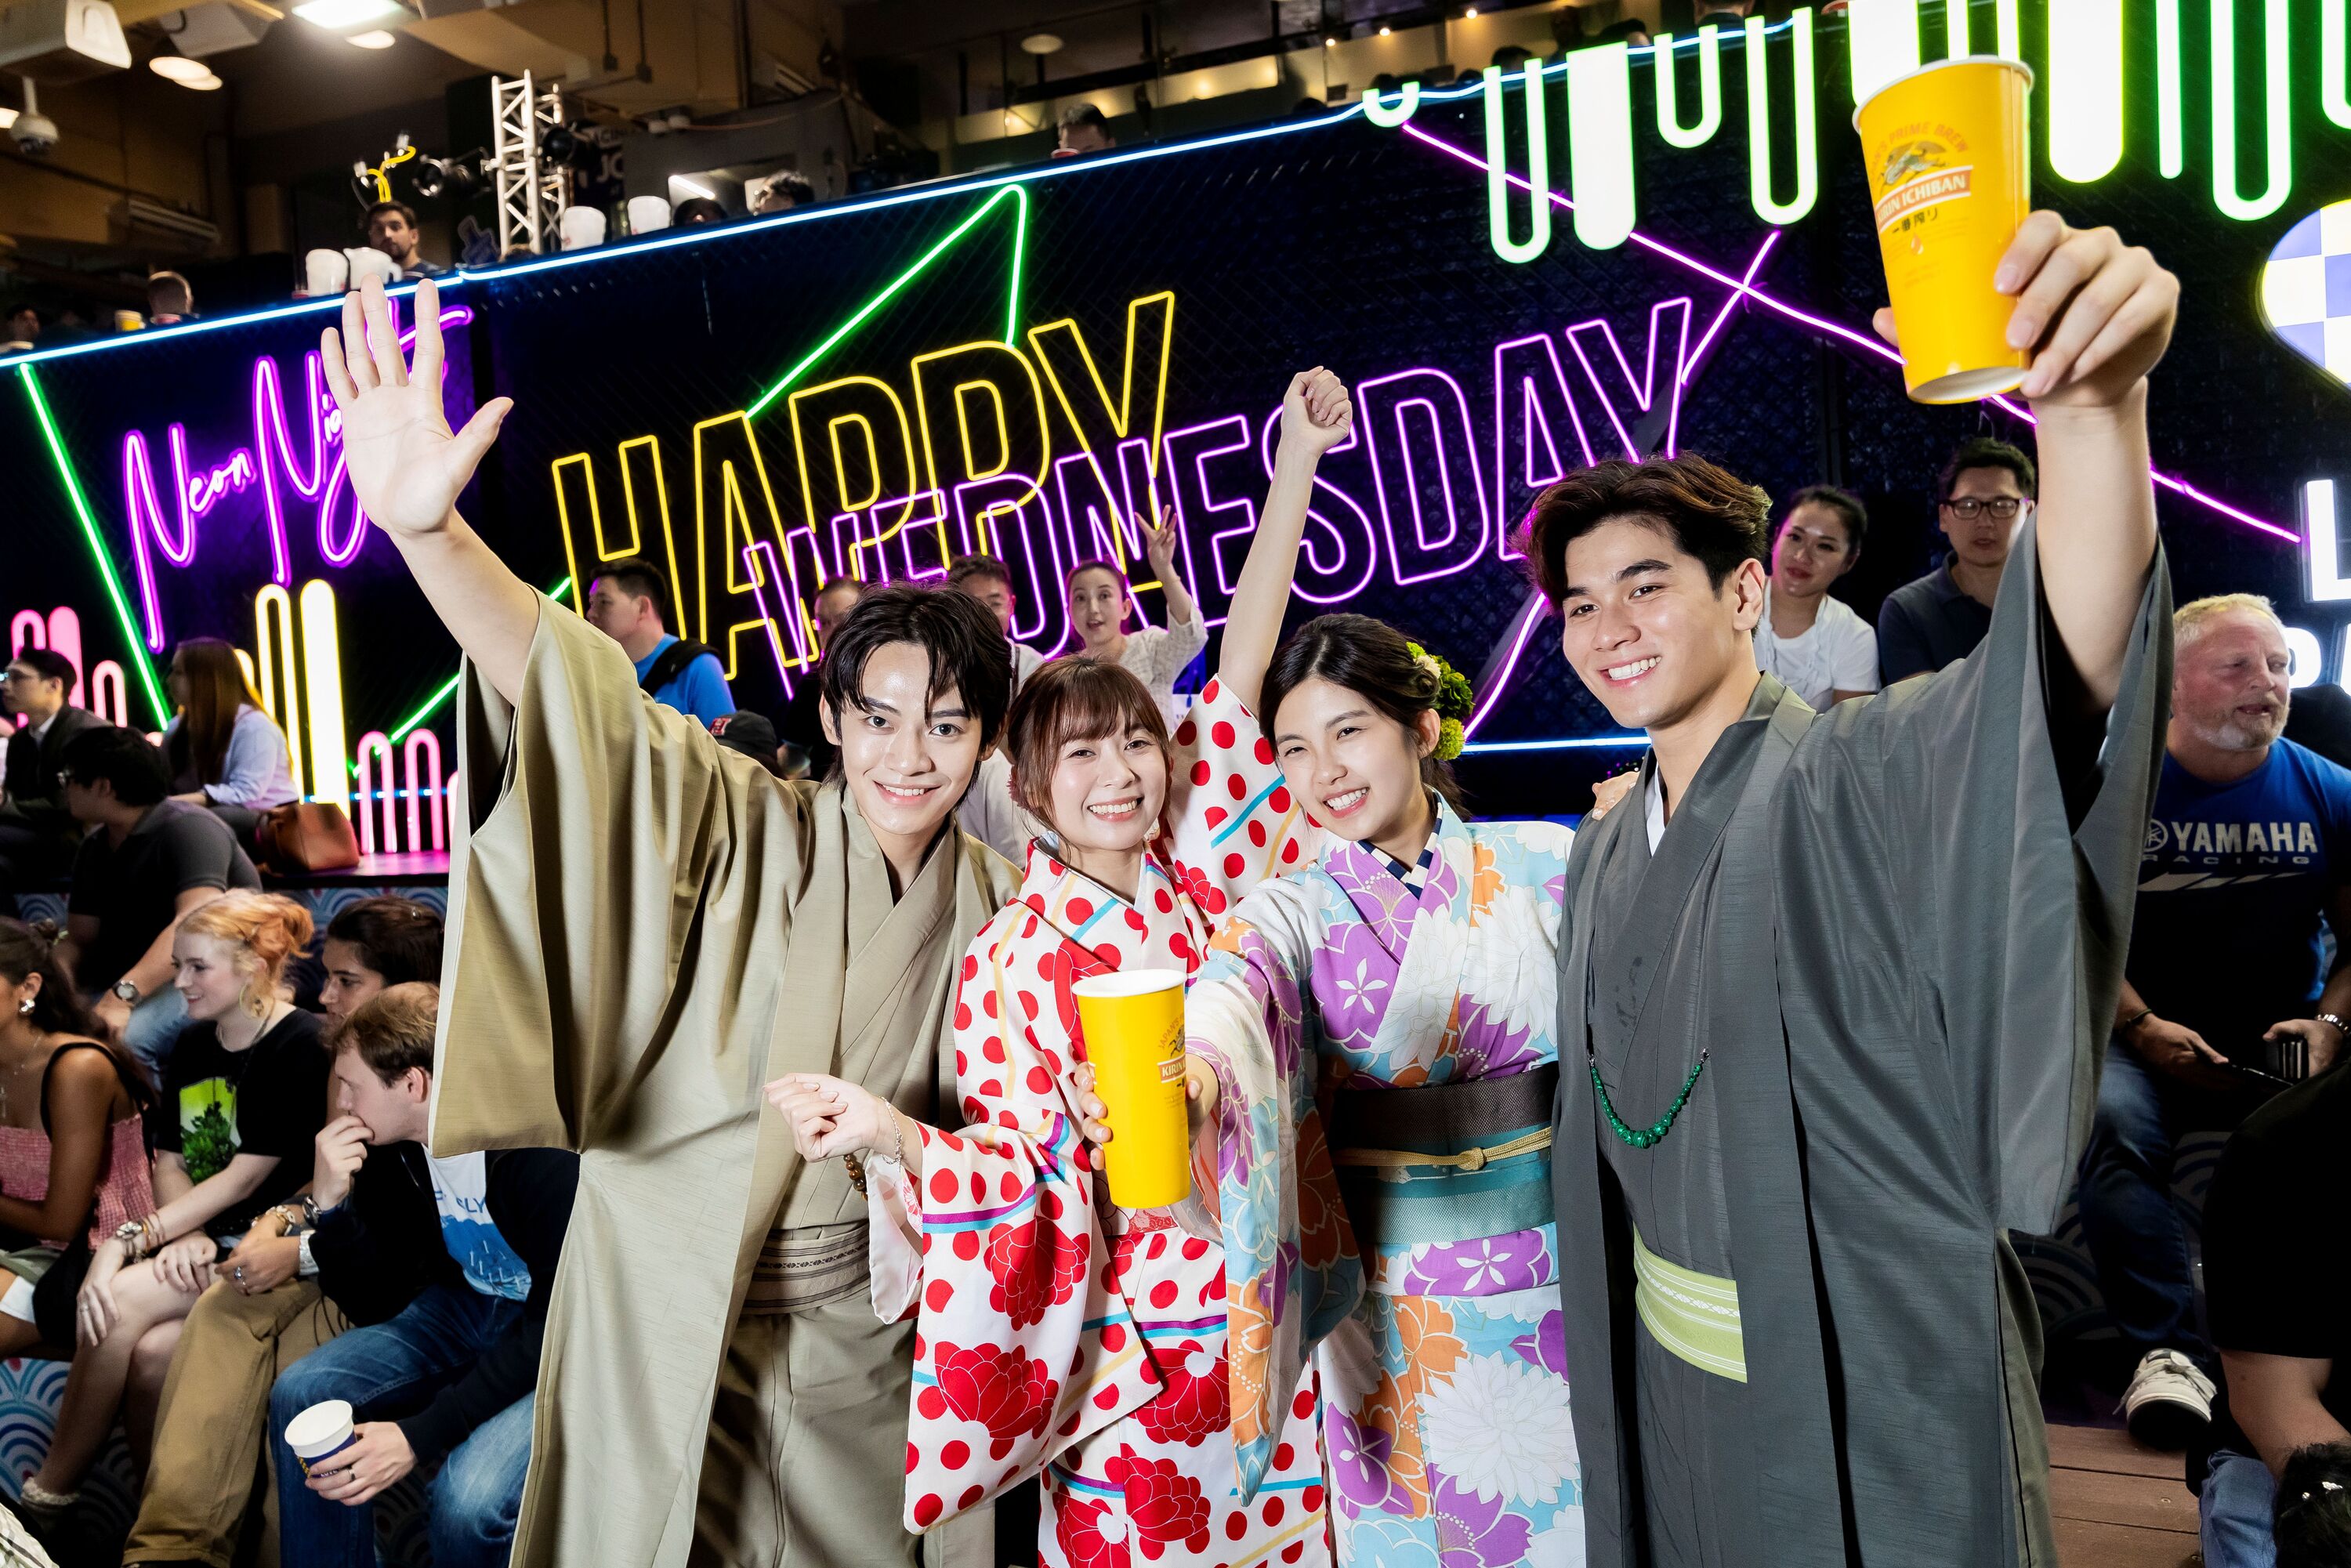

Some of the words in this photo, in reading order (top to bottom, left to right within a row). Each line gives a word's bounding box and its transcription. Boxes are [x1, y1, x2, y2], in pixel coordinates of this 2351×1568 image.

[1889, 121, 1931, 144] PRIME
[1933, 123, 1969, 153] BREW
[1902, 174, 1966, 206] ICHIBAN
[551, 290, 1176, 682] HAPPY
[742, 296, 1692, 701] WEDNESDAY
[122, 422, 257, 654] Neon
[2171, 821, 2318, 853] YAMAHA
[2142, 854, 2310, 865] RACING
[1158, 1017, 1182, 1049] JAPAN'S
[1161, 1061, 1183, 1077] KIRIN
